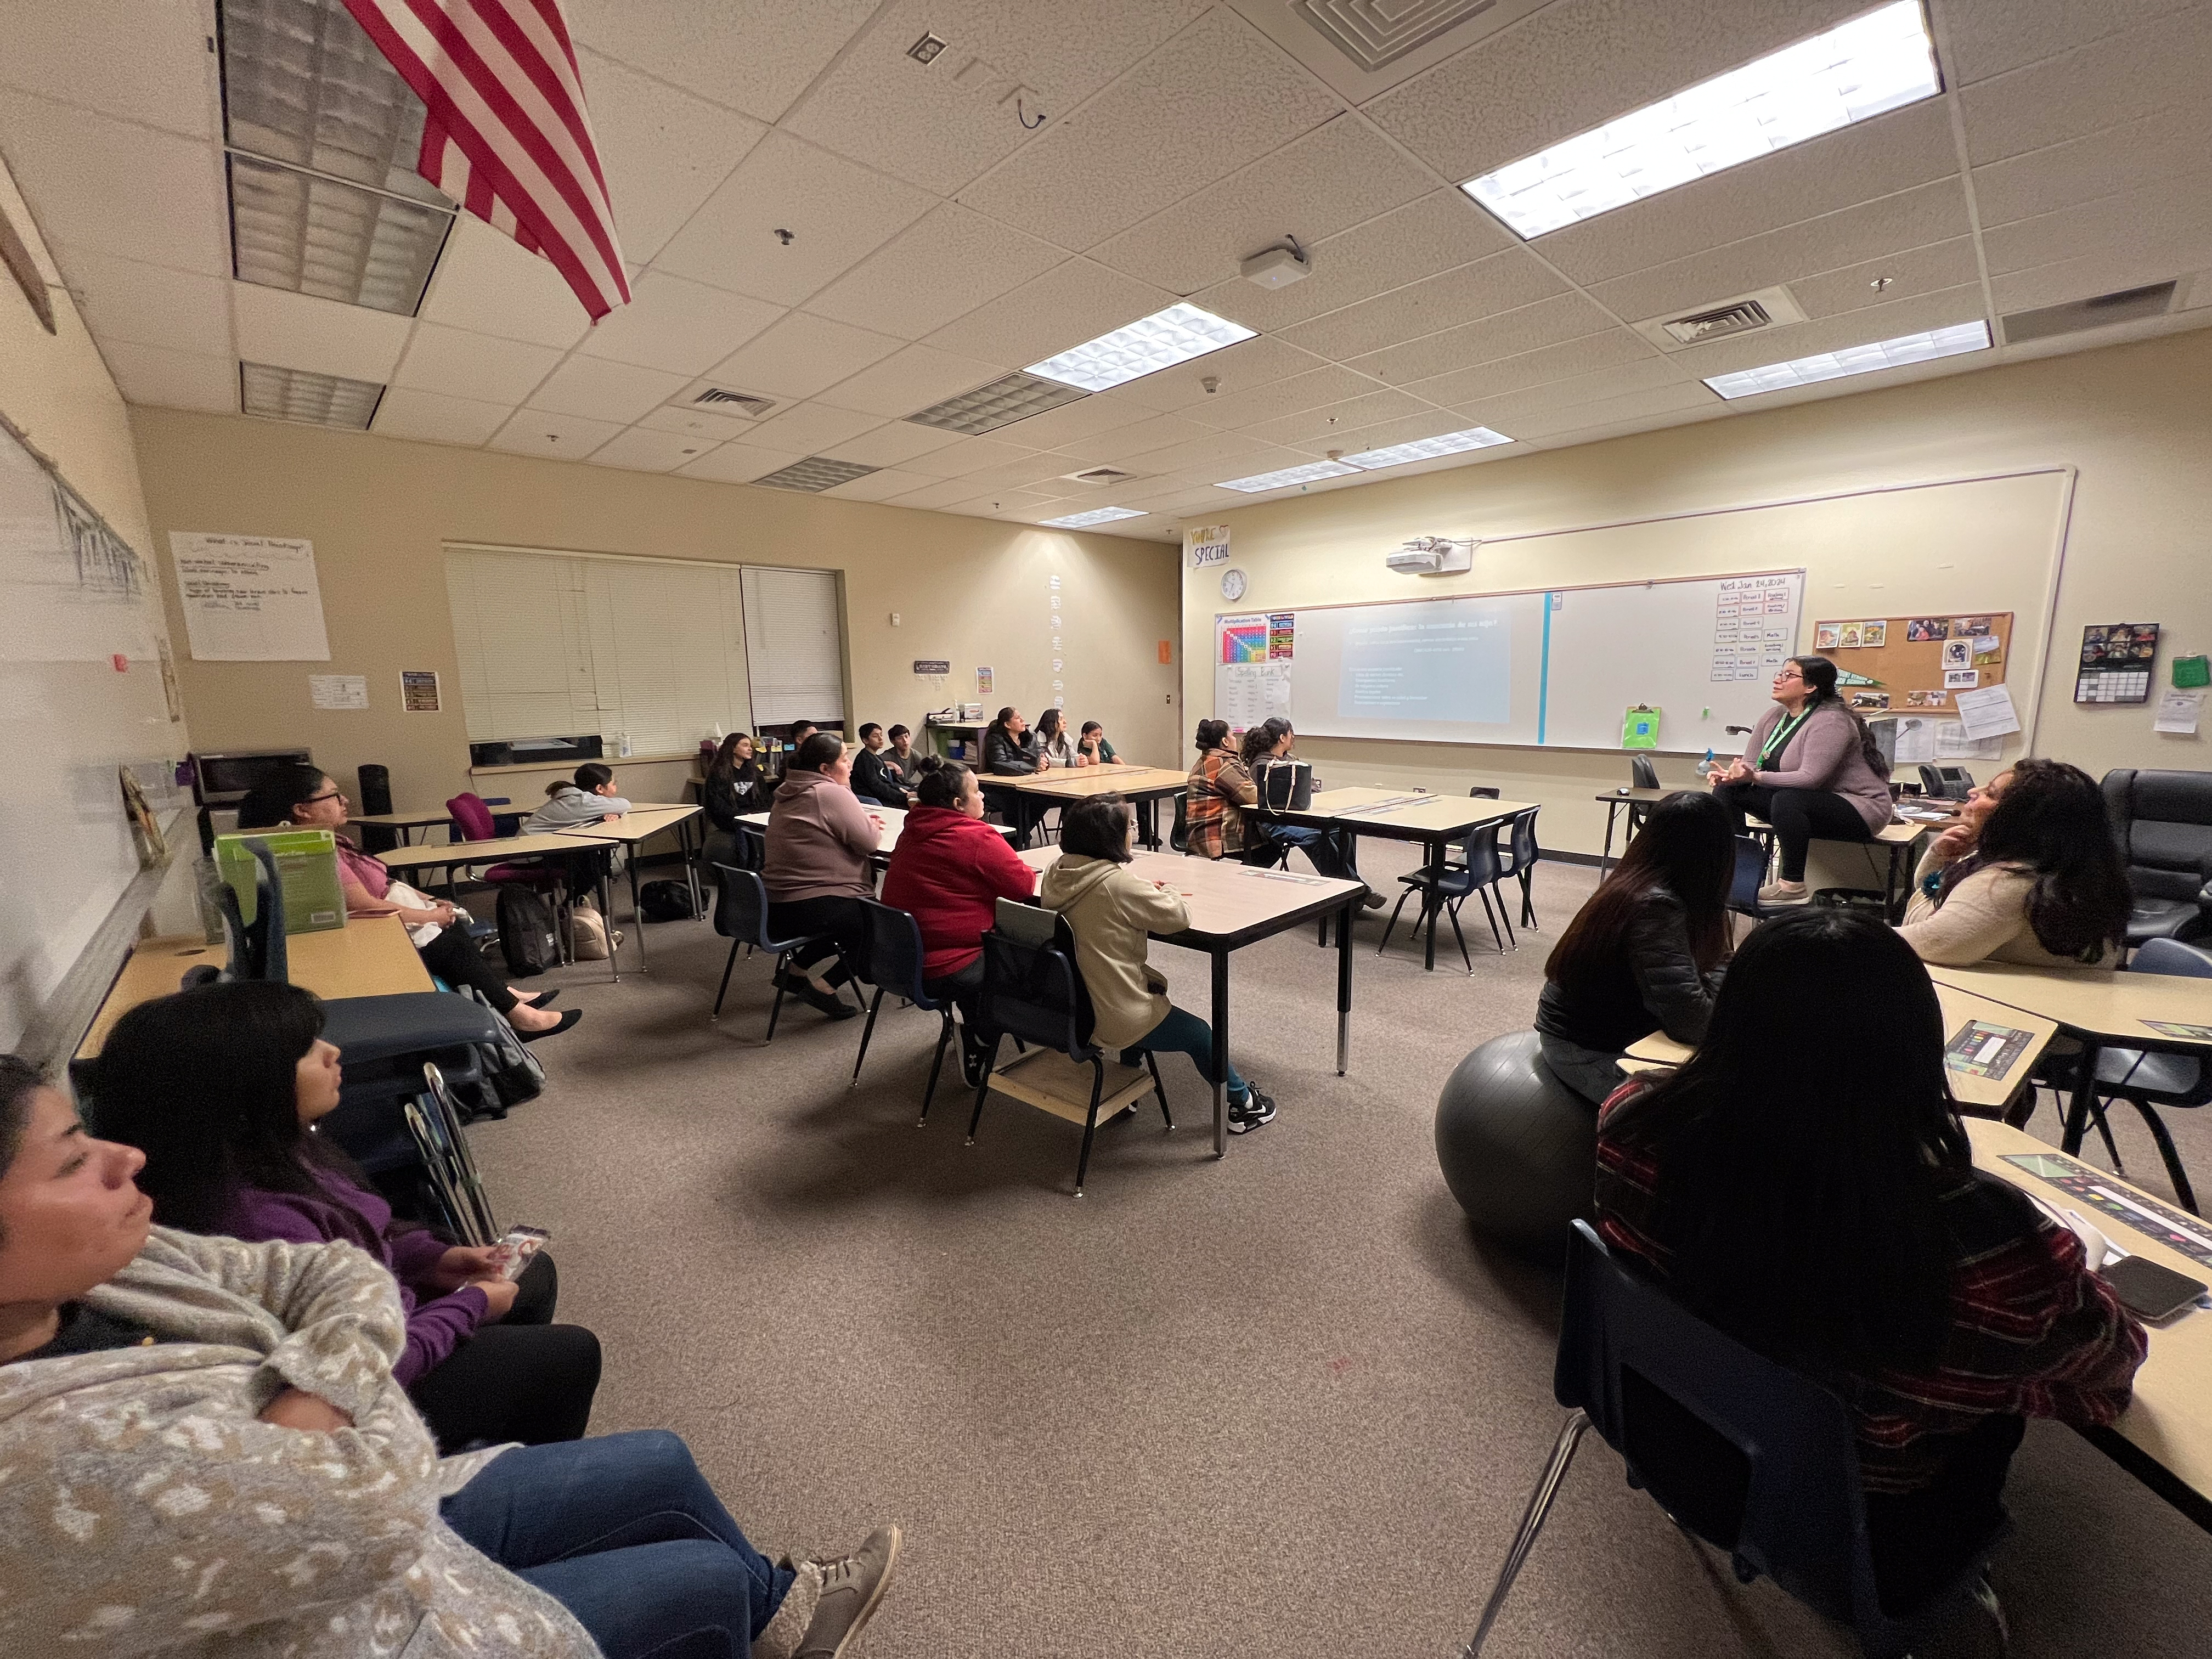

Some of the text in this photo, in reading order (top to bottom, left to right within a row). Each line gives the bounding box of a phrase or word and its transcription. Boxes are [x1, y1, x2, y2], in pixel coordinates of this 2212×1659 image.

[1195, 544, 1229, 565] SPECIAL
[1720, 581, 1735, 591] Wed
[1737, 580, 1752, 589] Jan
[1237, 667, 1256, 679] Spelling
